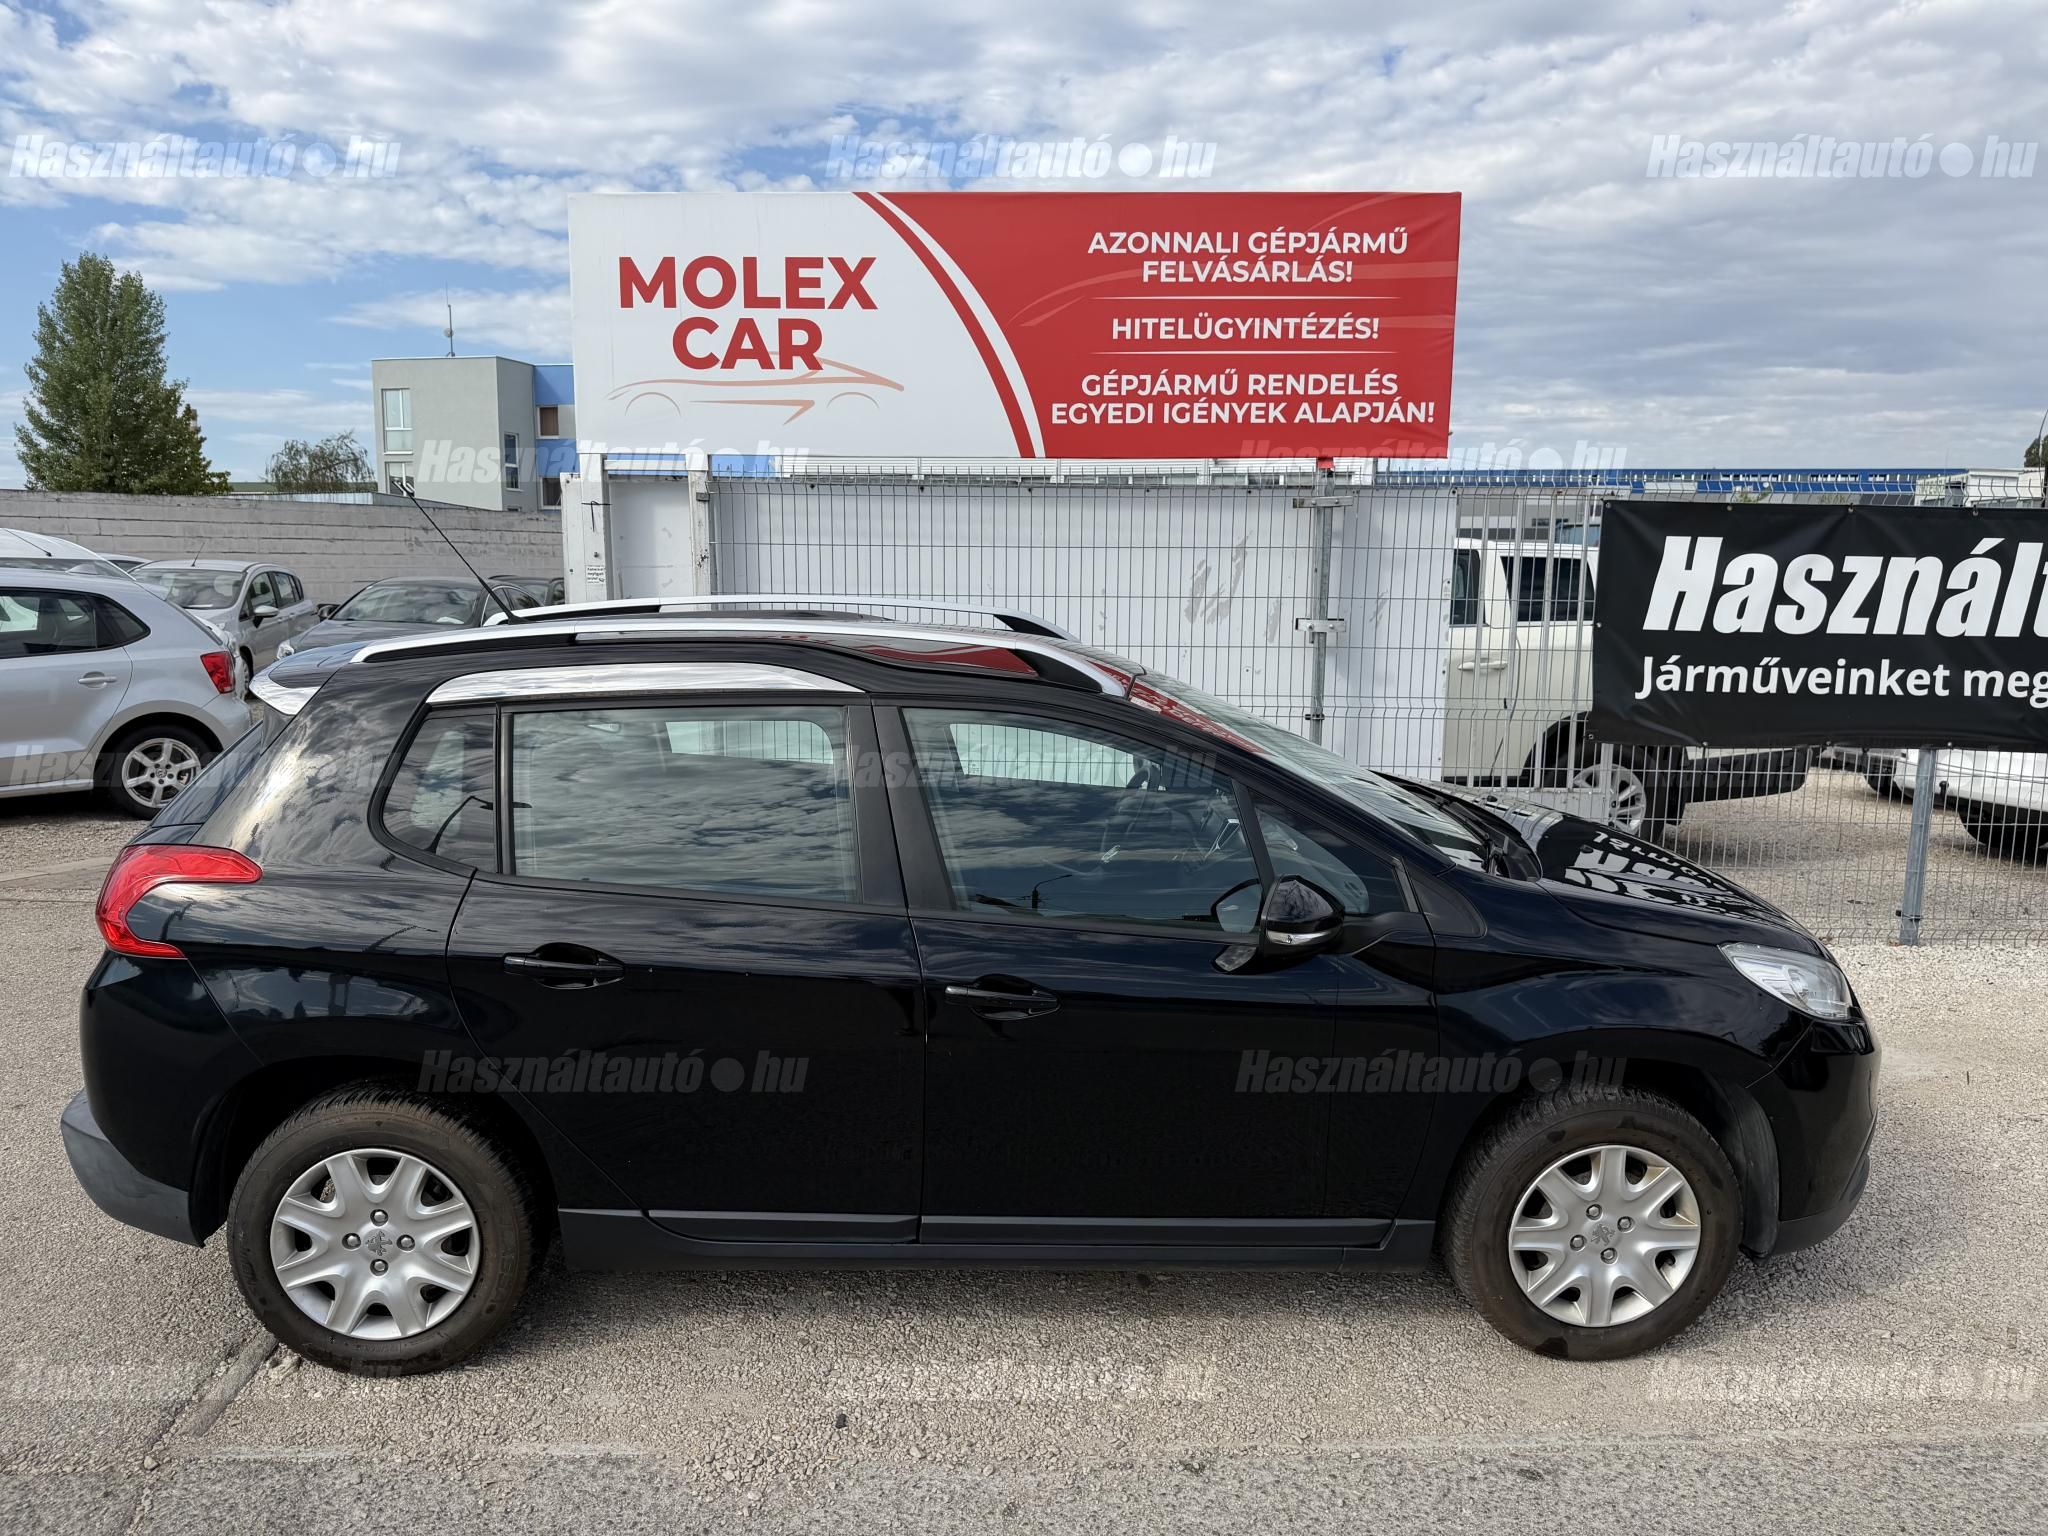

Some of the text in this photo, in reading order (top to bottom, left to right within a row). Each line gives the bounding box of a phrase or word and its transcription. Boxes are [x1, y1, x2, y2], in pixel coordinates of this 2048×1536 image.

[1088, 227, 1408, 255] AZONNALI GÉPJÁRMŰ
[618, 256, 878, 310] MOLEX
[1142, 256, 1353, 283] FELVÁSÁRLÁS!
[1112, 312, 1379, 340] HITELÜGYINTÉZÉS!
[672, 317, 823, 370] CAR
[1081, 369, 1398, 397] GÉPJÁRMŰ RENDELÉS
[1051, 397, 1434, 425] EGYEDI IGÉNYEK ALAPJÁN!
[1642, 535, 2048, 638] Használ
[1635, 655, 1951, 700] Járműveinket
